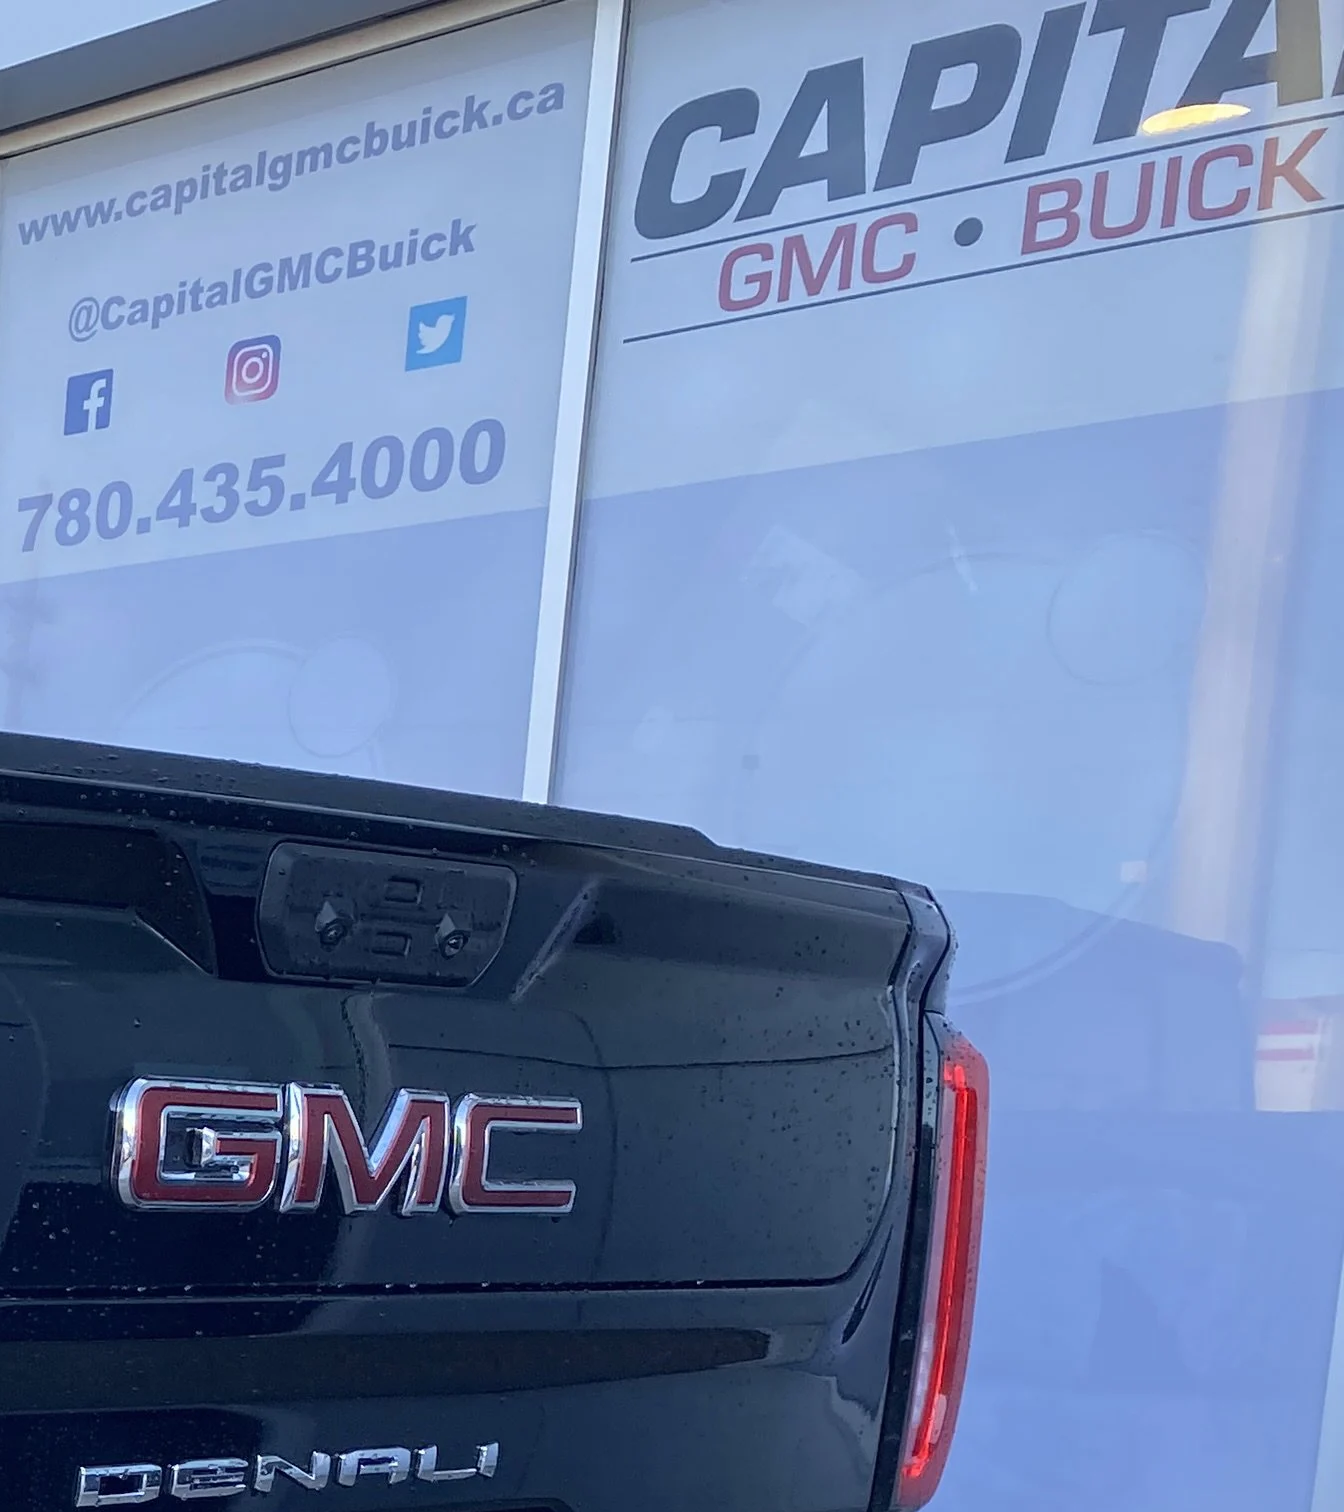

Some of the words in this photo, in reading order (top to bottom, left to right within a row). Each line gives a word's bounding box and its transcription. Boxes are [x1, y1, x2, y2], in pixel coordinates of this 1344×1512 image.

[18, 82, 566, 245] www.capitalgmcbuick.ca
[633, 0, 1344, 240] CAPITA
[68, 218, 478, 343] @CapitalGMCBuick
[717, 212, 918, 312] GMC
[1020, 128, 1329, 256] BUICK
[17, 418, 507, 553] 780.435.4000
[113, 1075, 584, 1215] GMC
[75, 1441, 501, 1508] DENALI
